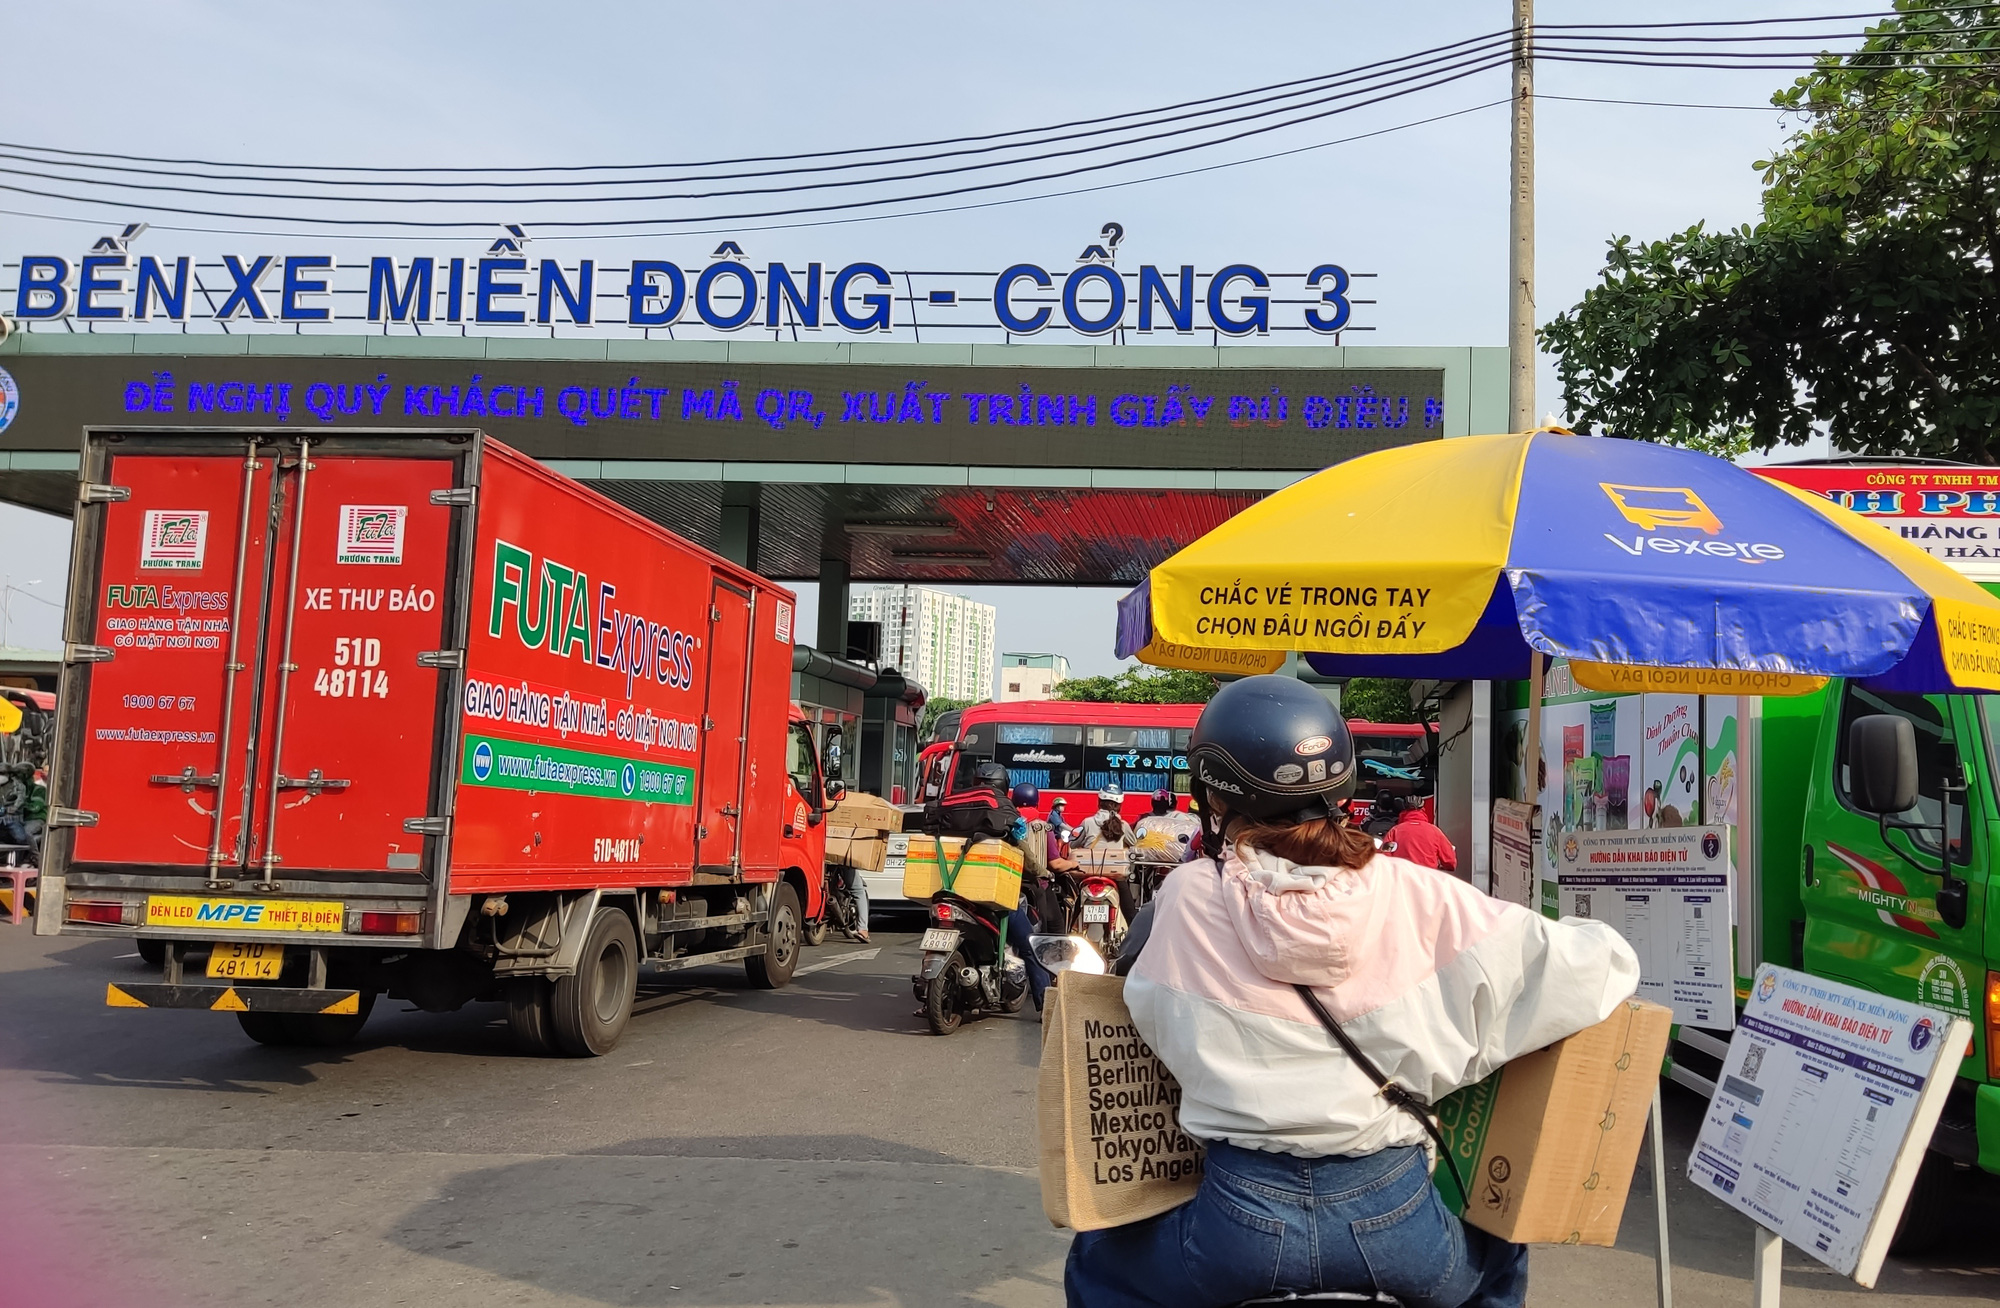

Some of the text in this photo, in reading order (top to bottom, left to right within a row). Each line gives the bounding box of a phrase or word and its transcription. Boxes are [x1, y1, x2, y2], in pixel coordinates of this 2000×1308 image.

[15, 222, 195, 321] BẾN
[213, 254, 336, 322] XE
[366, 223, 597, 327] MIỀN
[626, 240, 894, 333] ĐÔNG
[993, 221, 1271, 337] CỔNG
[1304, 263, 1352, 335] 3
[123, 371, 175, 413] ĐỀ
[187, 381, 292, 422] NGHỊ
[304, 372, 391, 422] QUÝ
[404, 374, 545, 419] KHÁCH
[557, 376, 669, 426] QUÉT
[681, 380, 746, 422] MÃ
[755, 386, 825, 431] QR,
[839, 379, 950, 425] XUẤT
[961, 382, 1097, 428] TRÌNH
[1110, 384, 1216, 428] GIẤY
[1229, 385, 1288, 428] ĐỦ
[1303, 384, 1409, 429] ĐIỀU
[1866, 472, 1998, 486] CÔNG TY TNHH TM
[1901, 523, 1987, 540] HÀNG
[1603, 533, 1785, 560] Vexere
[176, 560, 202, 568] TRANG
[373, 555, 400, 563] TRANG
[107, 585, 228, 615] FUTA Express
[304, 584, 435, 611] XE THƯ BÁO
[1200, 578, 1431, 608] CHẮC VÉ TRONG TAY
[106, 616, 230, 634] GIAO HÀNG TẬN NHÀ
[489, 538, 694, 700] FUTA Express
[1196, 612, 1426, 640] CHỌN ĐÂU NGỒI ĐẤY
[114, 634, 219, 651] CÓ MẶT NƠI NƠI
[334, 638, 381, 667] 51D
[314, 668, 389, 699] 48114
[123, 695, 196, 711] 1900 67 67
[465, 679, 505, 720] GIAO
[507, 681, 549, 728] HÀNG
[553, 690, 579, 740] TẬN
[581, 699, 608, 737] NHÀ
[616, 704, 634, 740] CÓ
[635, 708, 658, 752] MẶT
[659, 716, 678, 749] NƠI
[679, 720, 697, 752] NƠI
[96, 727, 216, 744] www.futaexpress.vn
[475, 754, 491, 767] www
[1107, 749, 1139, 768] TÝ
[498, 755, 687, 796] www.futaexpress.vn 1900 67 67
[1199, 758, 1244, 795] Vespa
[593, 838, 640, 863] 51D-48114
[1583, 836, 1599, 846] CÔNG
[1607, 837, 1623, 846] TNHH
[1624, 836, 1637, 846] MTV
[1627, 851, 1643, 863] KHAI
[1644, 849, 1658, 862] BÁO
[1660, 849, 1676, 865] ĐIỆN
[151, 902, 340, 926] ĐÈN LED MPE THIẾT BỊ ĐIỆN
[232, 943, 263, 958] 51D
[216, 960, 272, 976] 481.14
[1782, 979, 1800, 993] CÔNG
[1800, 983, 1809, 993] TY
[1809, 986, 1827, 1000] TNHH
[1827, 991, 1842, 1005] MTV
[1085, 1020, 1141, 1039] Mont
[1781, 998, 1805, 1017] HƯỚNG
[1822, 1011, 1840, 1028] KHAI
[1841, 1014, 1858, 1035] BÁO
[1859, 1020, 1879, 1043] ĐIỆN
[1086, 1039, 1155, 1063] Londo
[1088, 1059, 1174, 1087] Berlin/C
[1091, 1108, 1165, 1136] Mexico
[1094, 1162, 1133, 1185] Los
